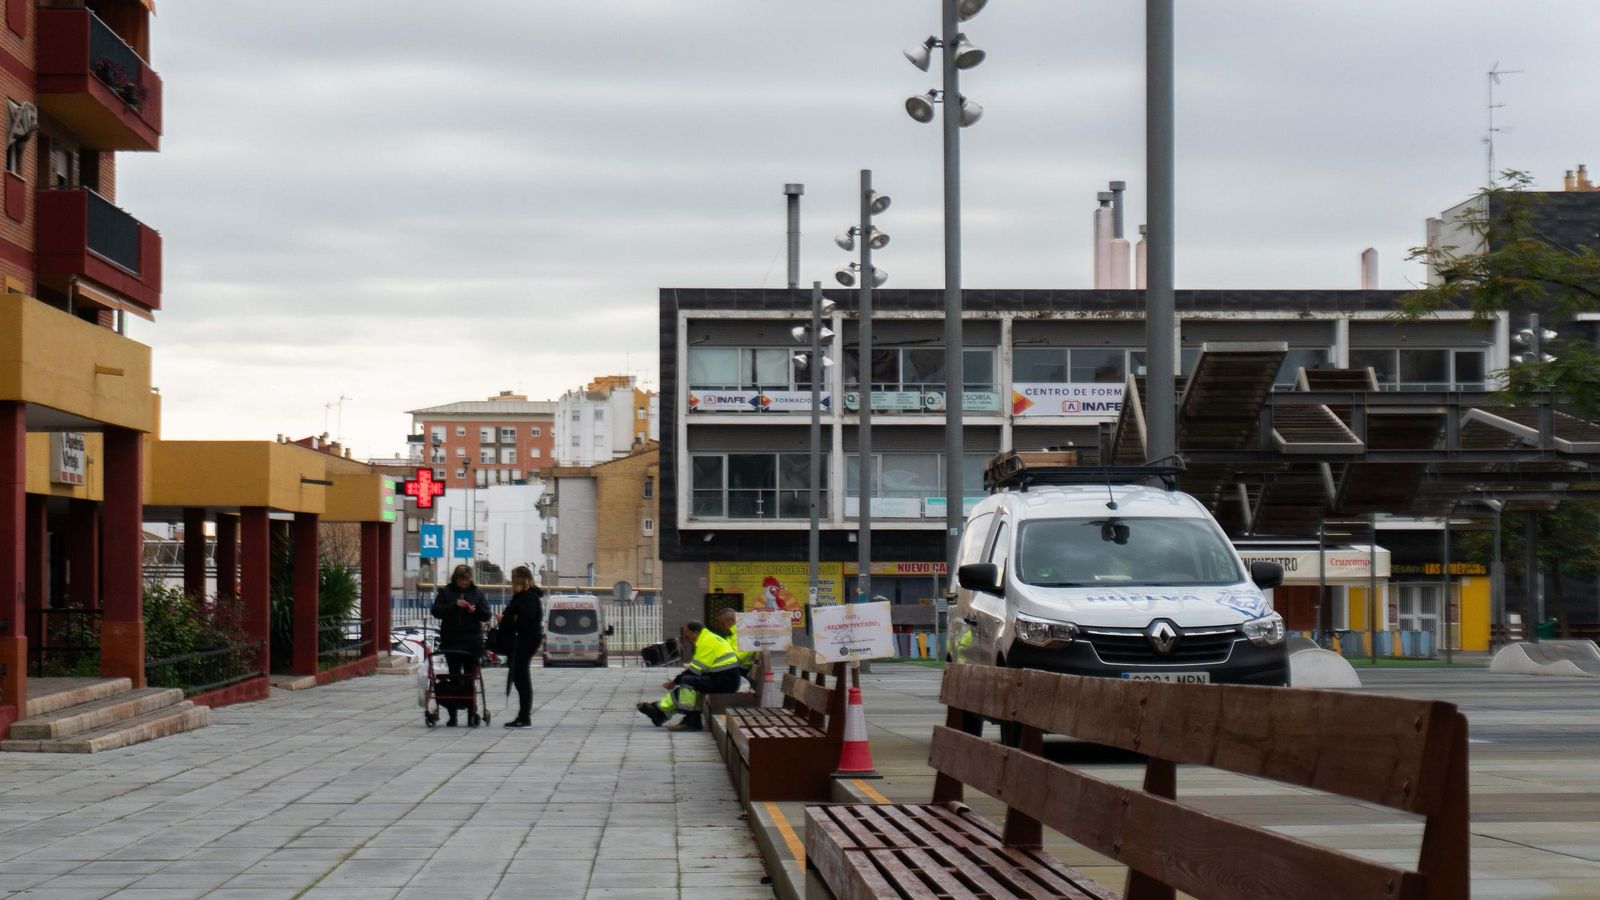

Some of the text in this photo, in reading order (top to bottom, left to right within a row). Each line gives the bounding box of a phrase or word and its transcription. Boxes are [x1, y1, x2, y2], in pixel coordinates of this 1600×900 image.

[1025, 388, 1122, 396] CENTRO DE FORM
[717, 396, 746, 404] INAFE
[1082, 402, 1122, 411] INAFE
[1330, 557, 1371, 567] Cruzcamp
[897, 563, 930, 573] NUEVO
[932, 563, 946, 573] CA
